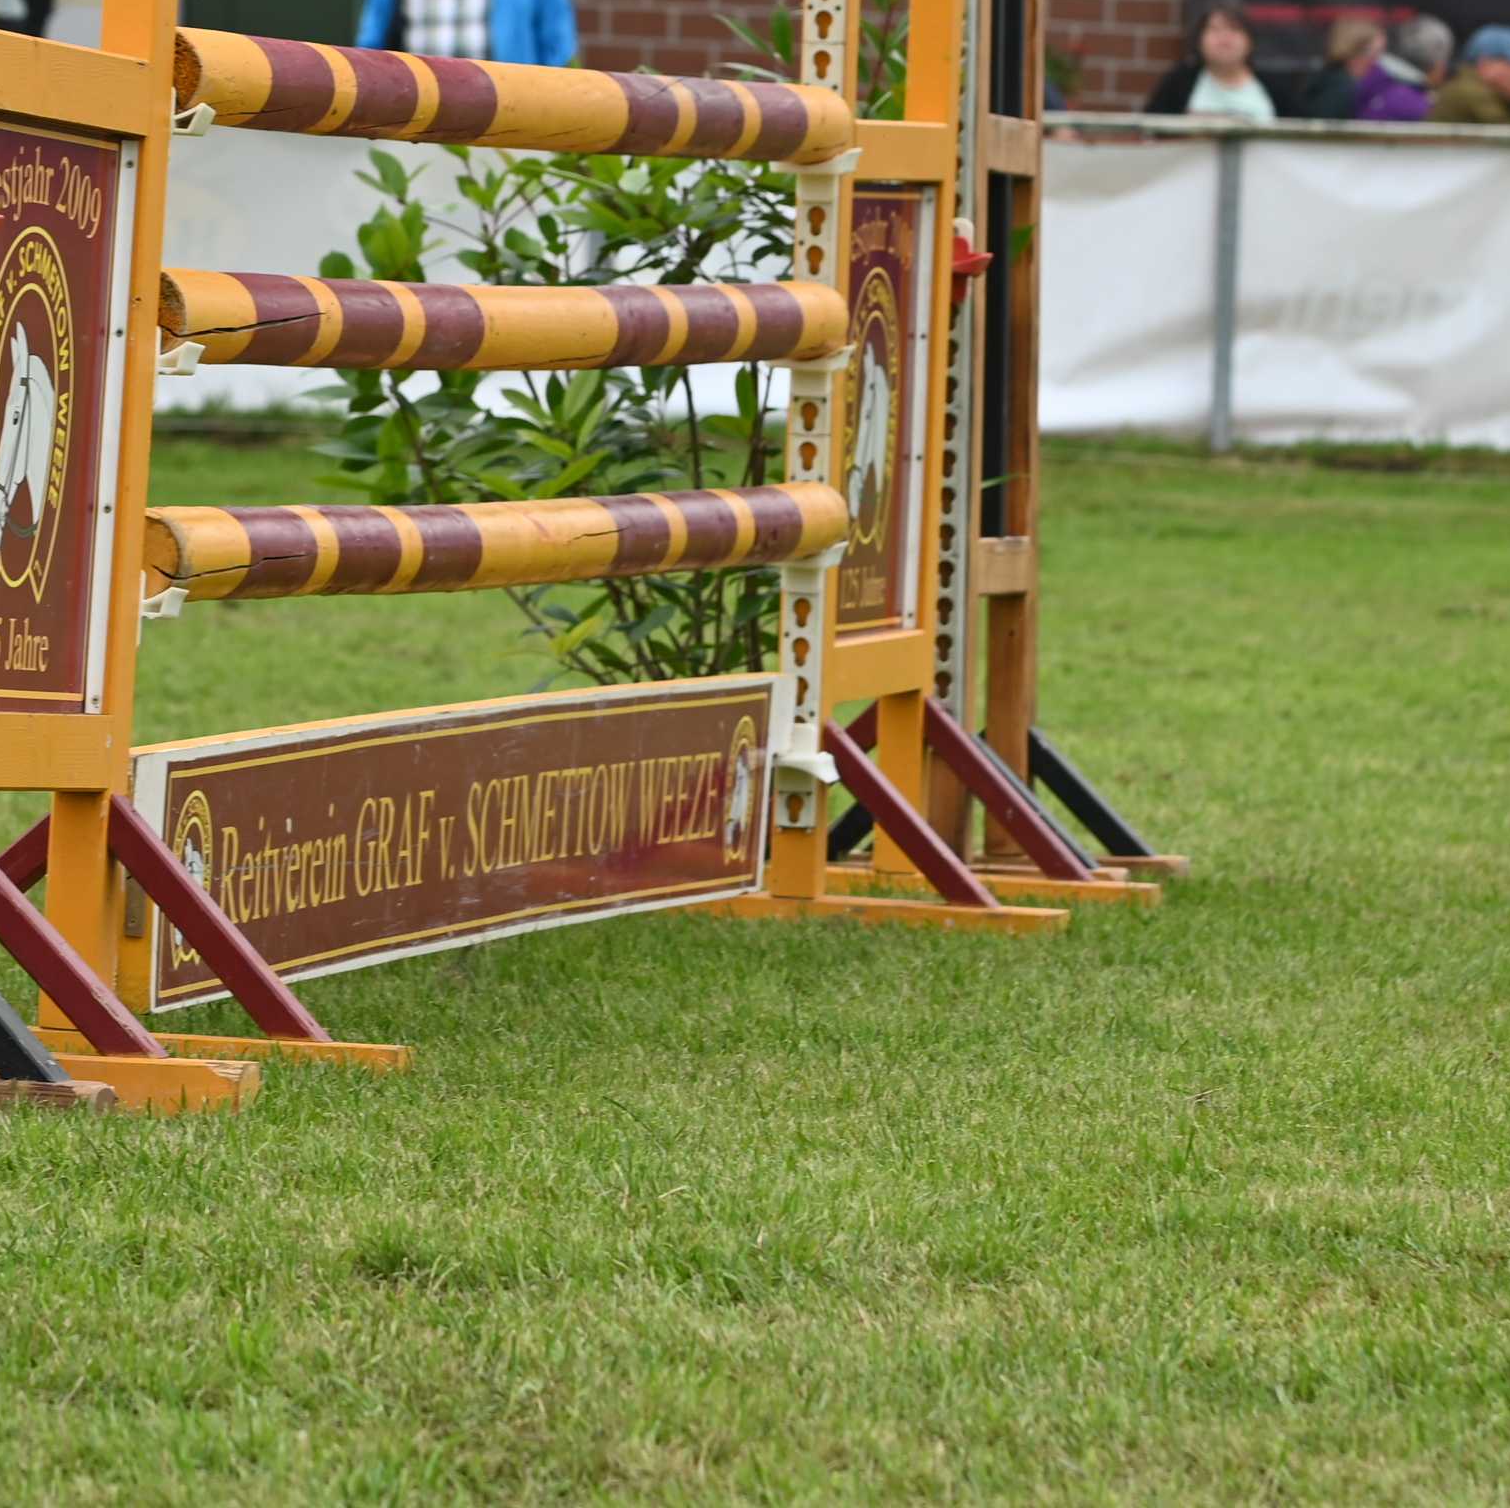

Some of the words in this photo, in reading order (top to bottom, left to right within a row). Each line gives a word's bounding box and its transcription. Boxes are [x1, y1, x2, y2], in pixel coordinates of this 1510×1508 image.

[55, 156, 102, 239] 2009
[18, 240, 70, 372] SCHMETTOW
[47, 391, 69, 510] WEEZE
[3, 616, 50, 673] Jahre
[220, 803, 347, 925] Reitverein
[354, 789, 436, 897] GRAF
[439, 814, 456, 881] v.
[464, 759, 636, 878] SCHMETTOW
[638, 749, 722, 845] WEEZE
